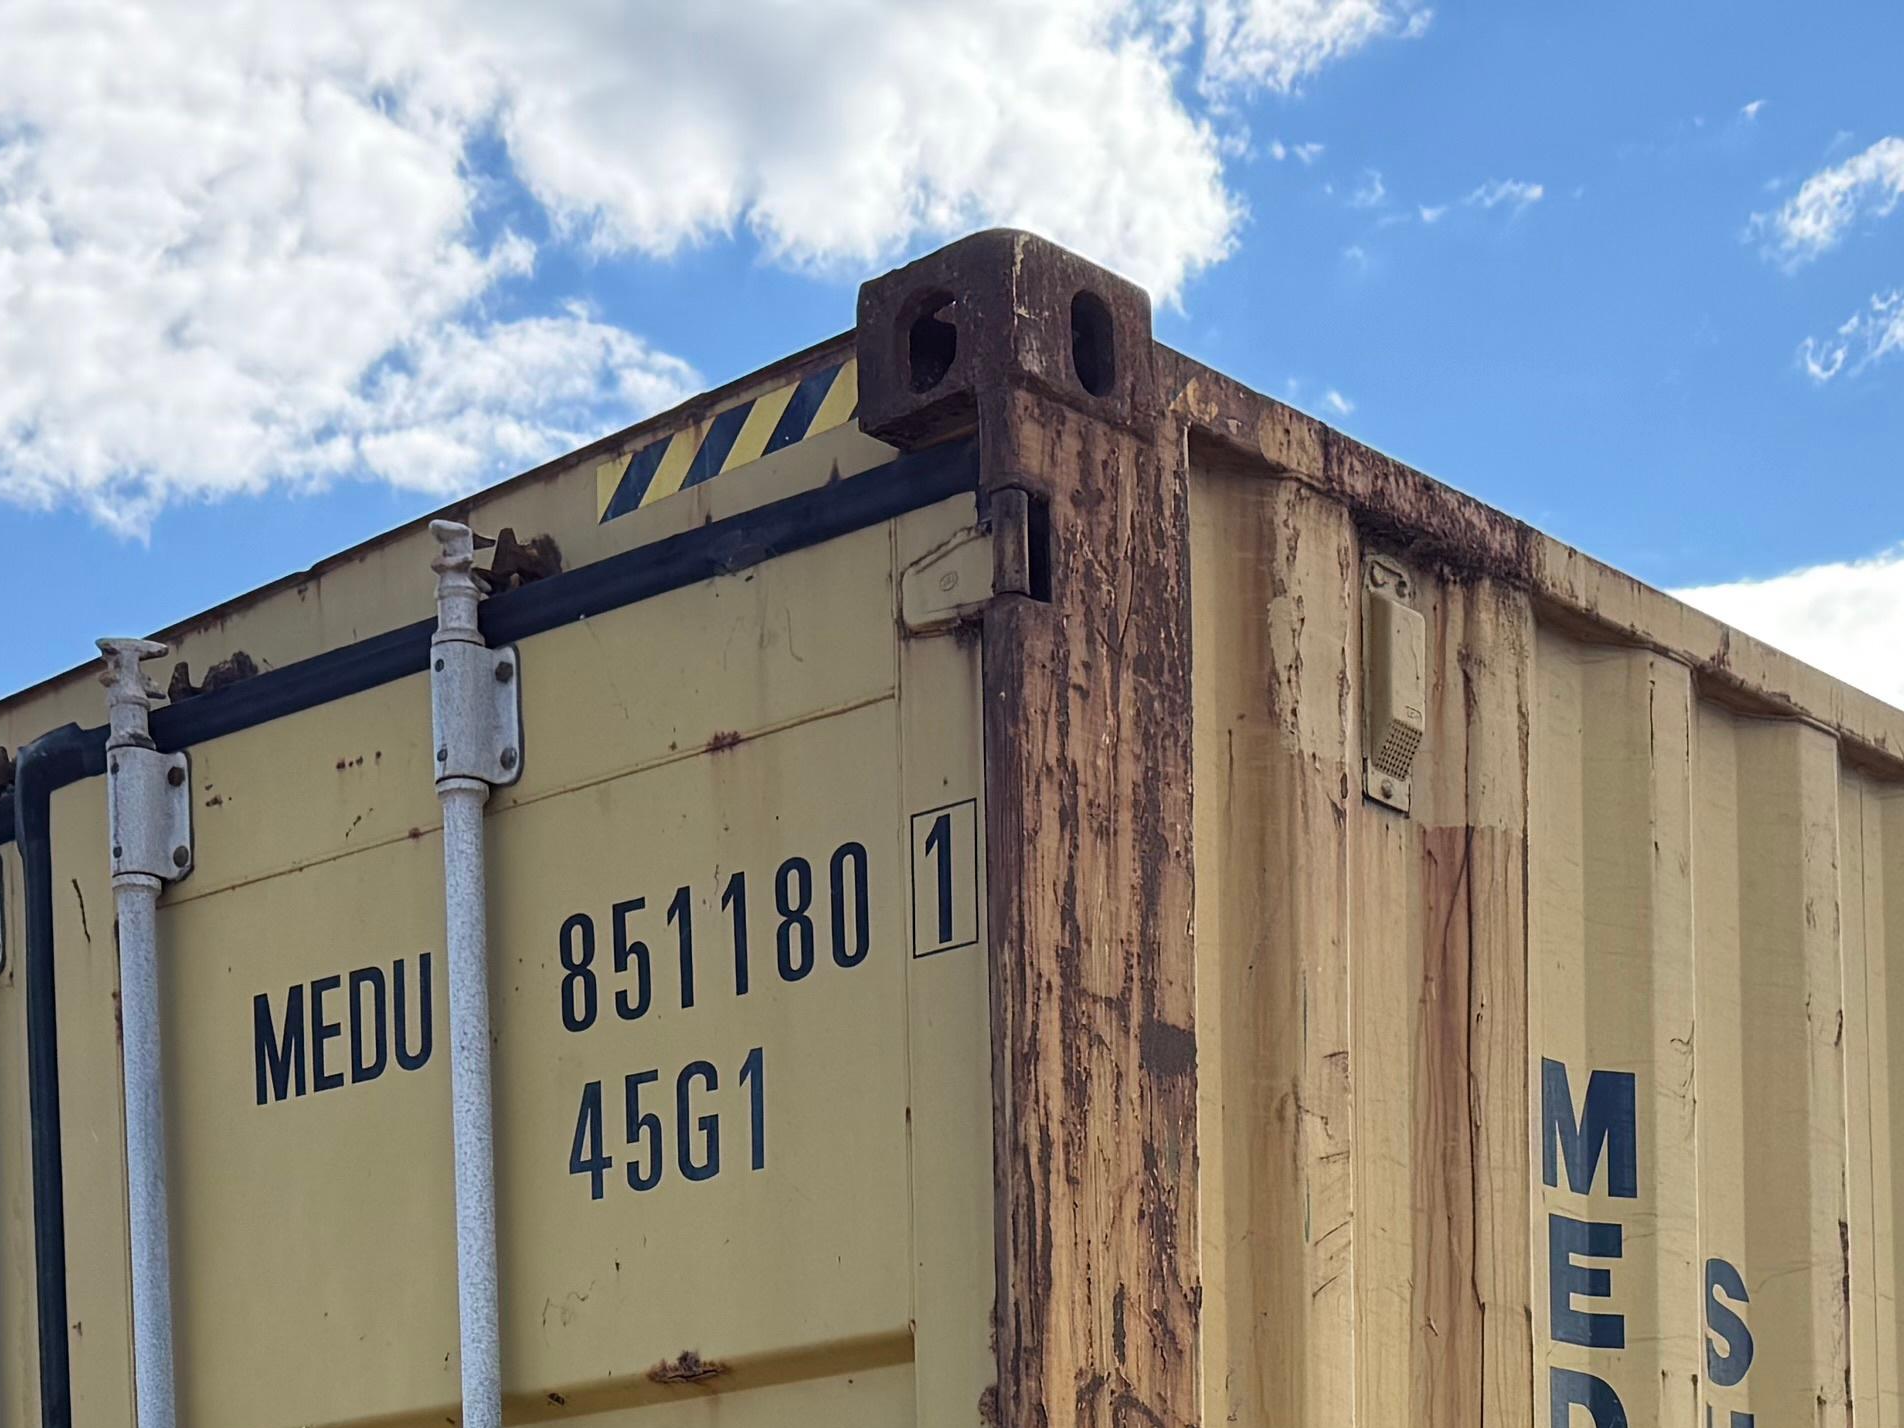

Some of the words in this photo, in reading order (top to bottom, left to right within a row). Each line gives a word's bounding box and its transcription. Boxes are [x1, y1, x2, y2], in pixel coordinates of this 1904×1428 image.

[253, 951, 434, 1107] MEDU
[559, 841, 870, 1033] 851180
[923, 812, 954, 946] 1
[568, 1046, 766, 1200] 45G1
